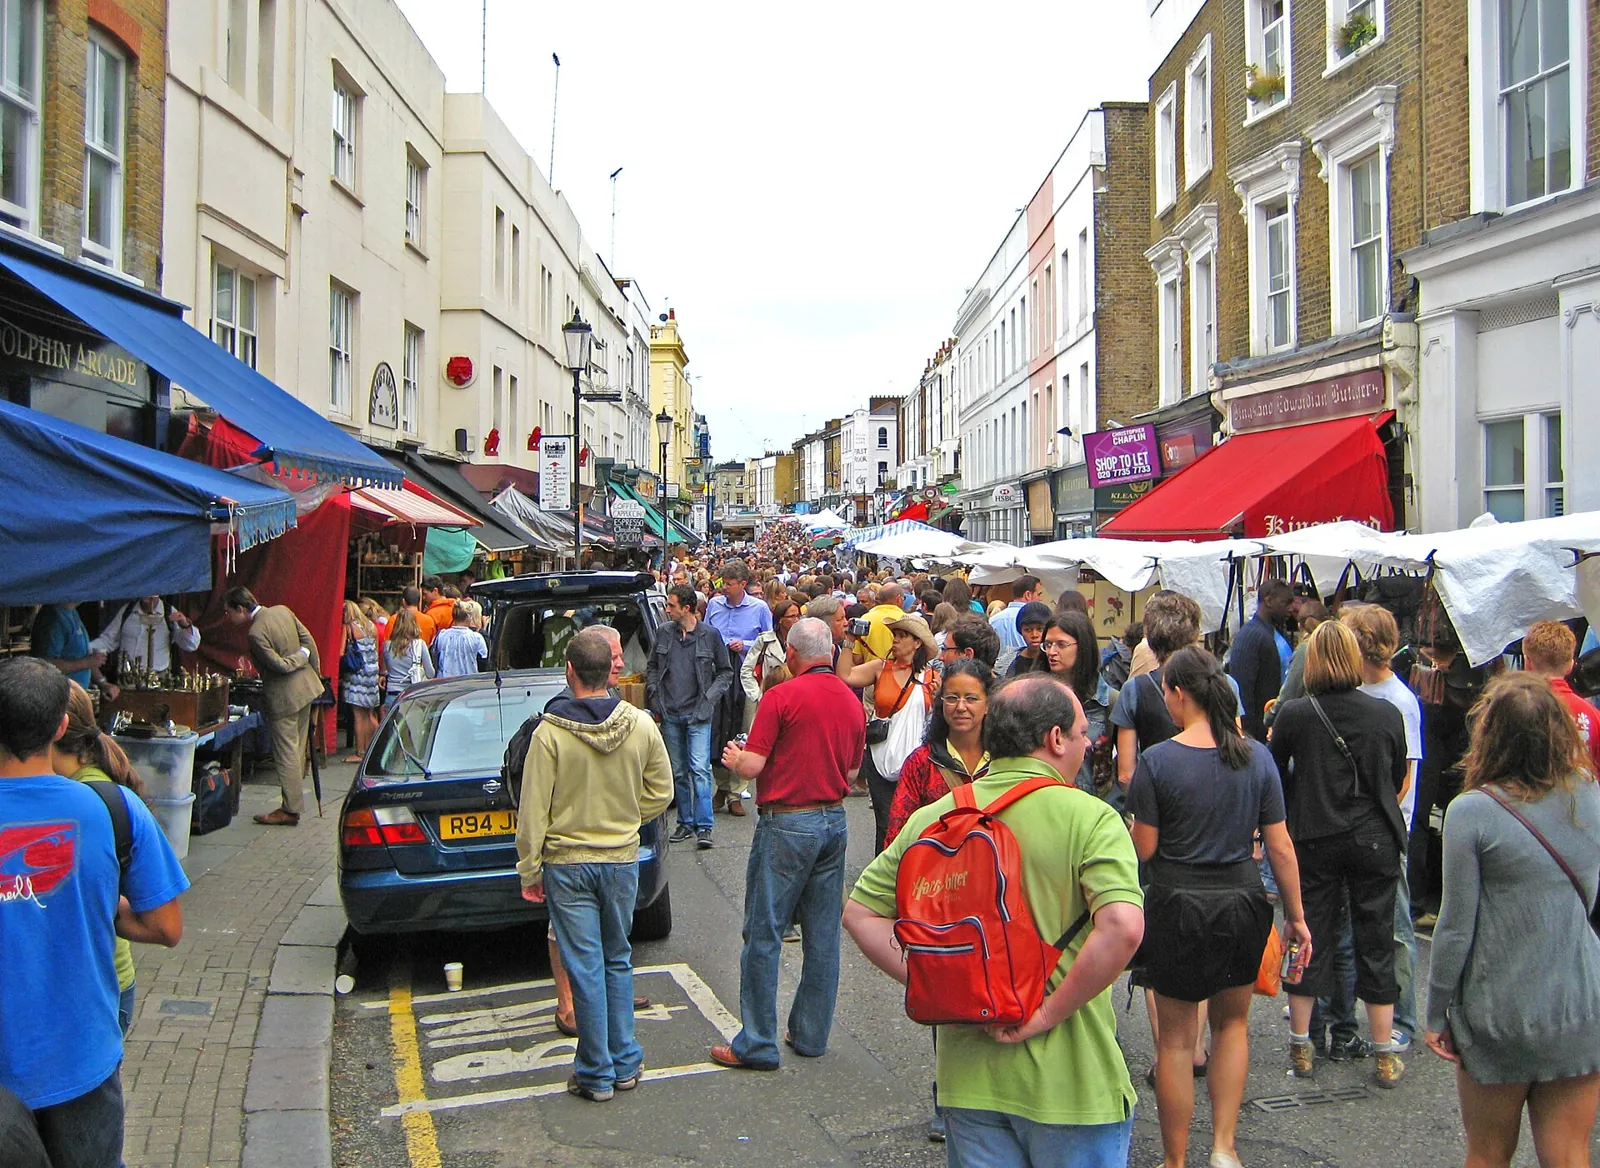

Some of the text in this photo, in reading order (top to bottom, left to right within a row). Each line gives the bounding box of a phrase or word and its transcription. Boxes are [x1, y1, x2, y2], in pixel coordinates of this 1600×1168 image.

[0, 326, 137, 386] OLPHIN ARCADE
[1331, 383, 1379, 404] Butchers
[1111, 427, 1145, 438] CHRISTOPHER
[1112, 432, 1147, 446] CHAPLIN
[1095, 451, 1149, 472] SHOP TO LET
[1097, 465, 1151, 479] 020 7735 7733
[613, 519, 644, 527] ESPRESSO
[614, 533, 642, 543] MOCHA
[450, 814, 493, 835] R94
[945, 871, 968, 890] otter
